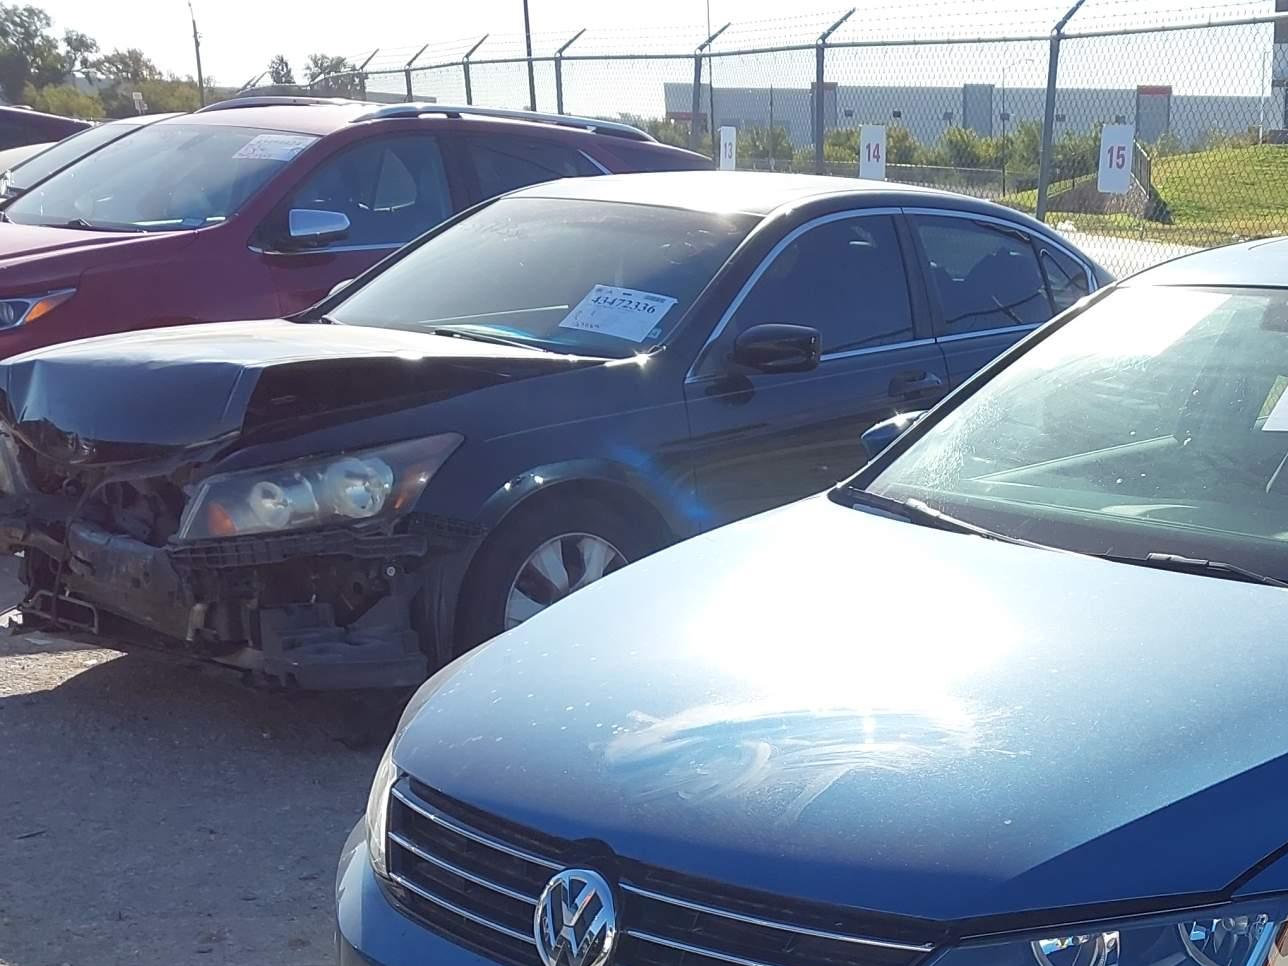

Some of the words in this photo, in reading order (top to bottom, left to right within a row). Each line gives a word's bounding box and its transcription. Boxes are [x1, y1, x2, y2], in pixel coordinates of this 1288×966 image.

[723, 142, 734, 160] 13
[865, 142, 881, 164] 14
[1107, 145, 1127, 170] 15
[591, 295, 657, 315] 43472336
